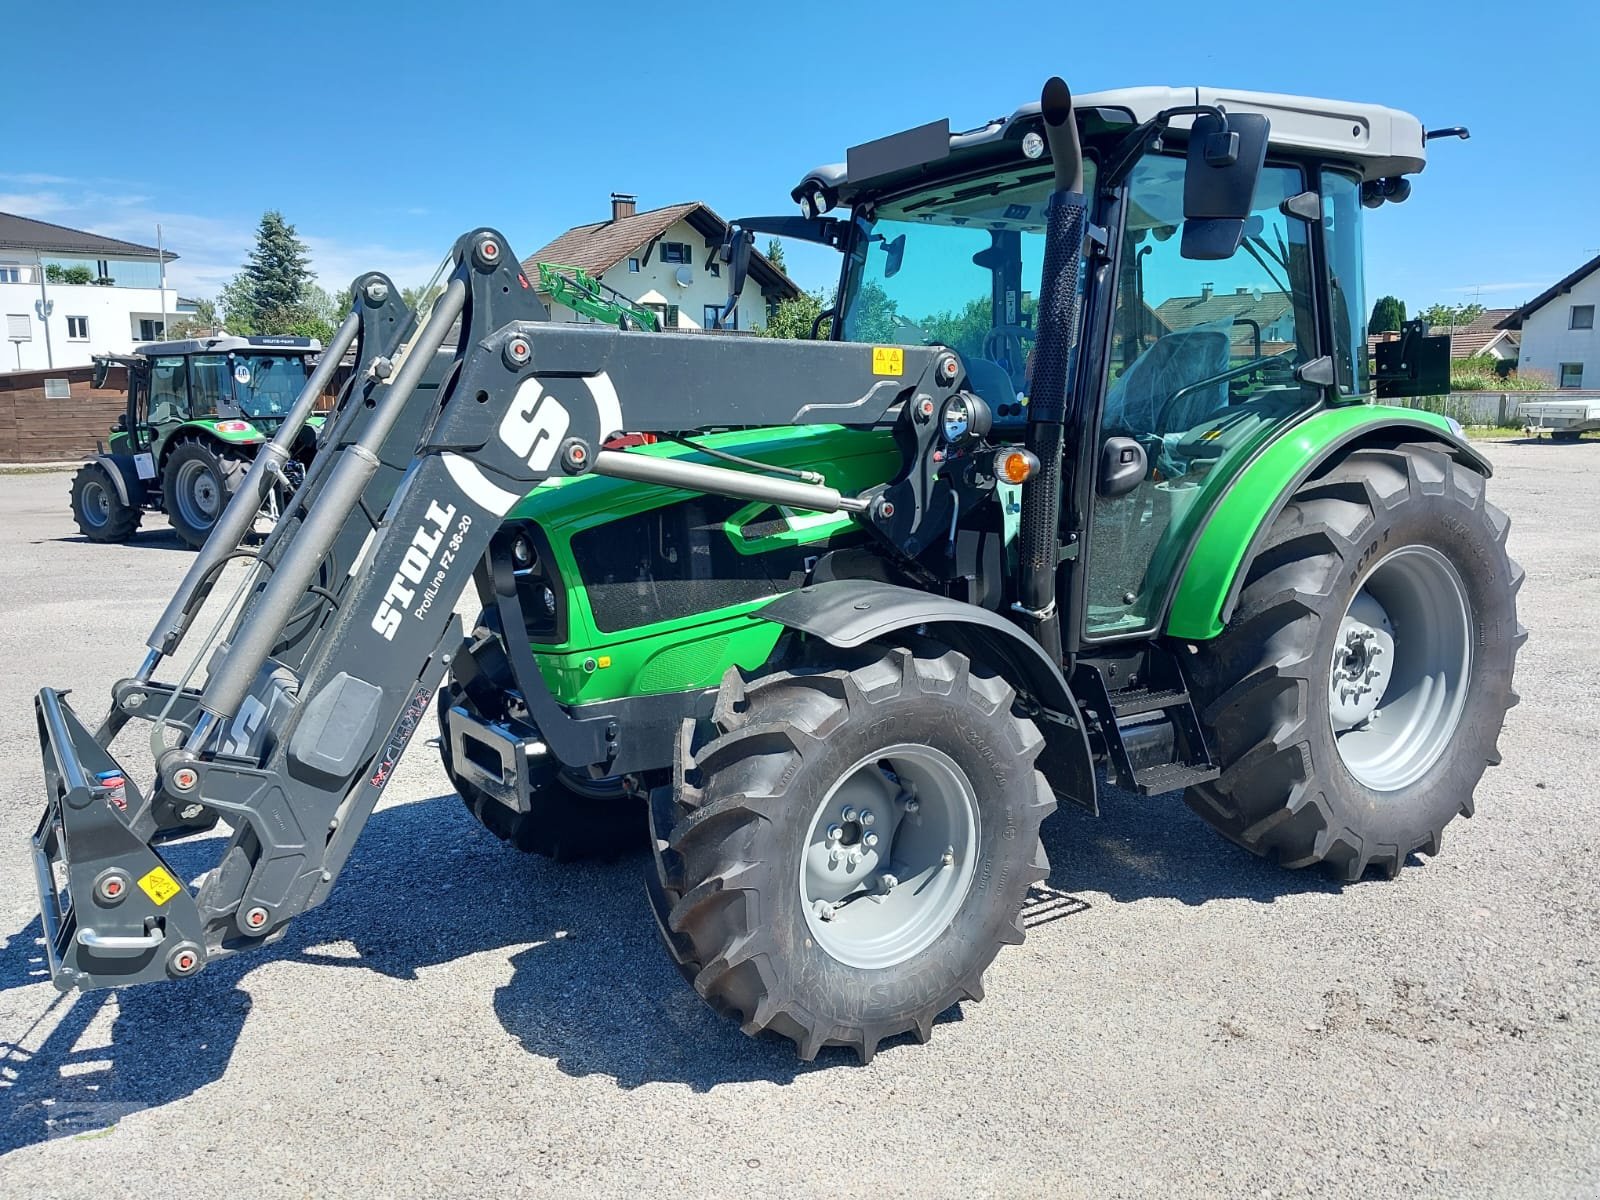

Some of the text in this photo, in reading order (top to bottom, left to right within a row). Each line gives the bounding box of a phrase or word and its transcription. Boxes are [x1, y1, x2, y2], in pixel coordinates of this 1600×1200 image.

[371, 499, 457, 641] STOLL
[414, 514, 473, 621] ProfiLine FZ 36-20
